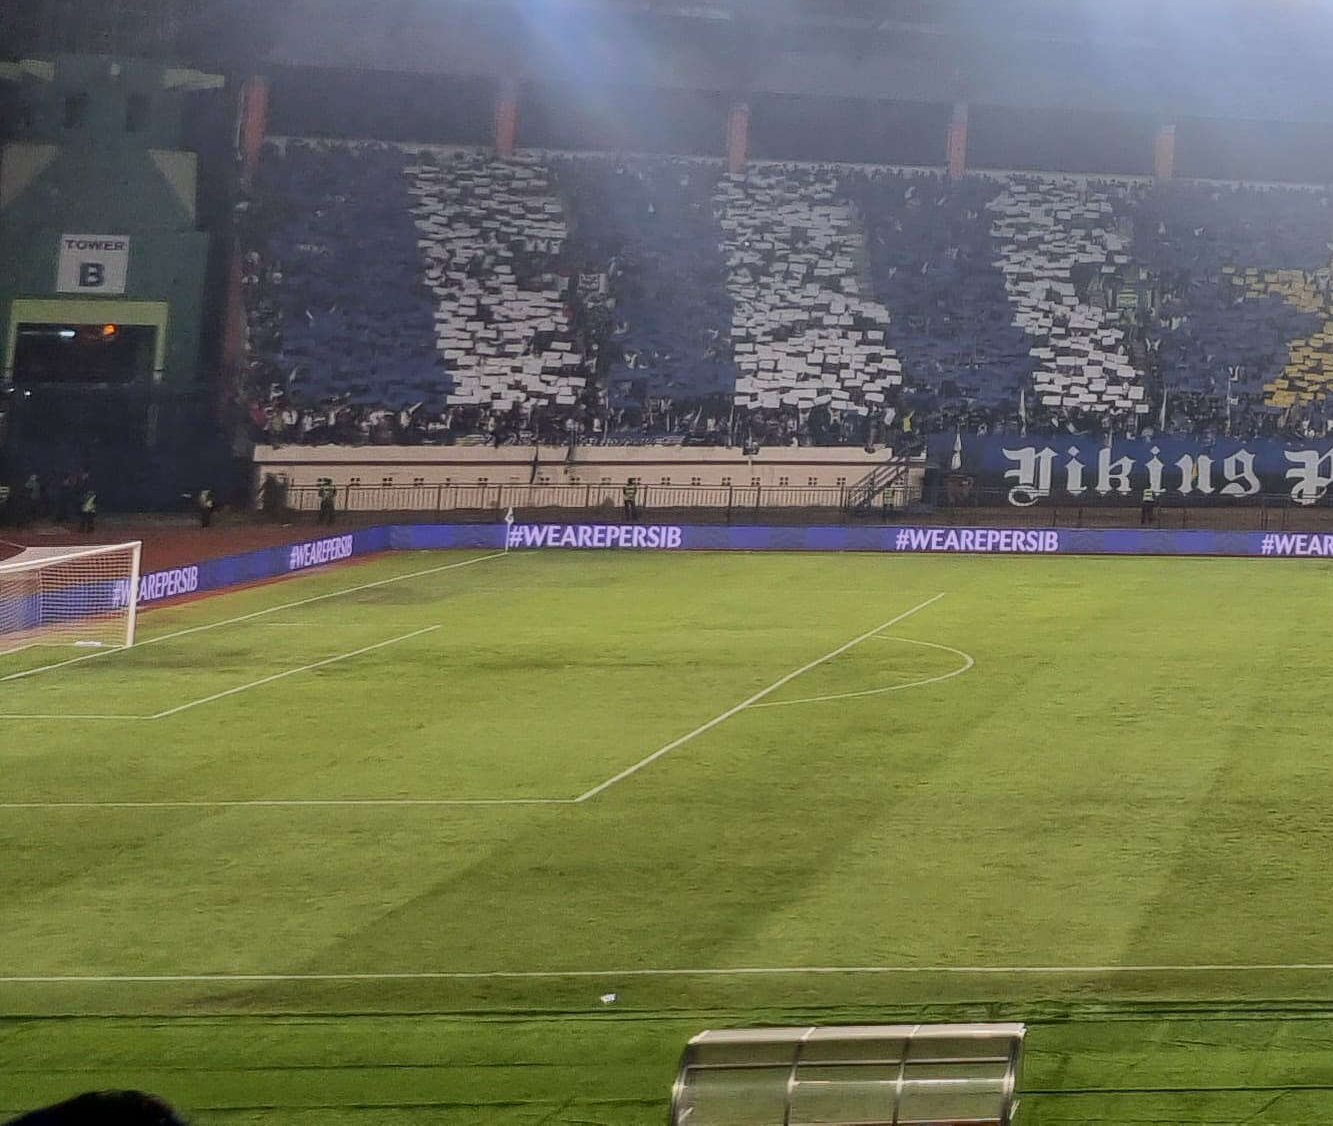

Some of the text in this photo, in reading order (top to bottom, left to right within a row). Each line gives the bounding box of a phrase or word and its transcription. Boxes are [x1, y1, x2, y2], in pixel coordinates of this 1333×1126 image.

[65, 240, 125, 250] TOWER
[79, 262, 105, 286] B
[1002, 446, 1261, 507] Viking
[509, 526, 681, 549] #WEAREPERSIB
[896, 529, 1058, 552] #WEAREPERSIB
[289, 535, 353, 571] #WEAREPERSIB
[112, 566, 199, 608] #WAREPERSIB
